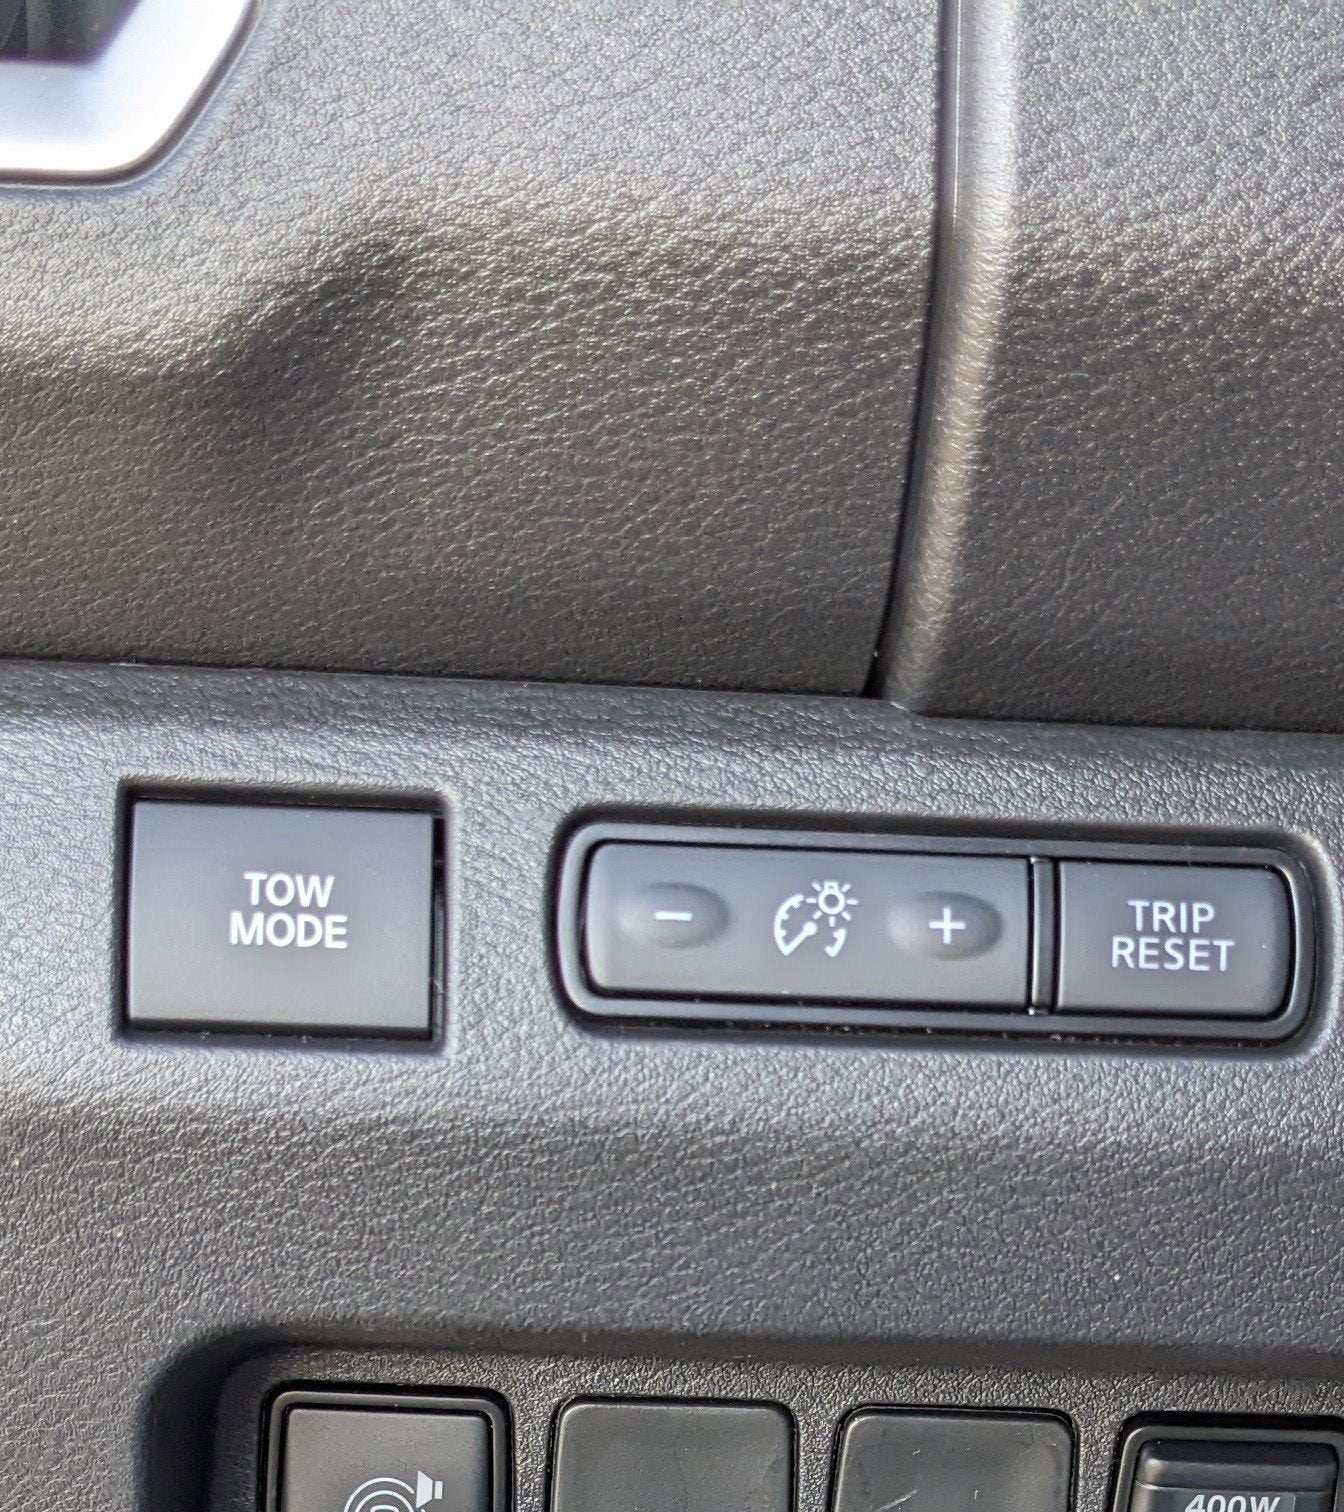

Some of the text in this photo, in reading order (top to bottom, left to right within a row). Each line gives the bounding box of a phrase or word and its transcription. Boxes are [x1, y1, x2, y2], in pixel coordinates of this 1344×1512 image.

[242, 872, 335, 908] TOW
[230, 911, 348, 949] MODE
[1128, 900, 1215, 934] TRIP
[1111, 935, 1235, 972] RESET
